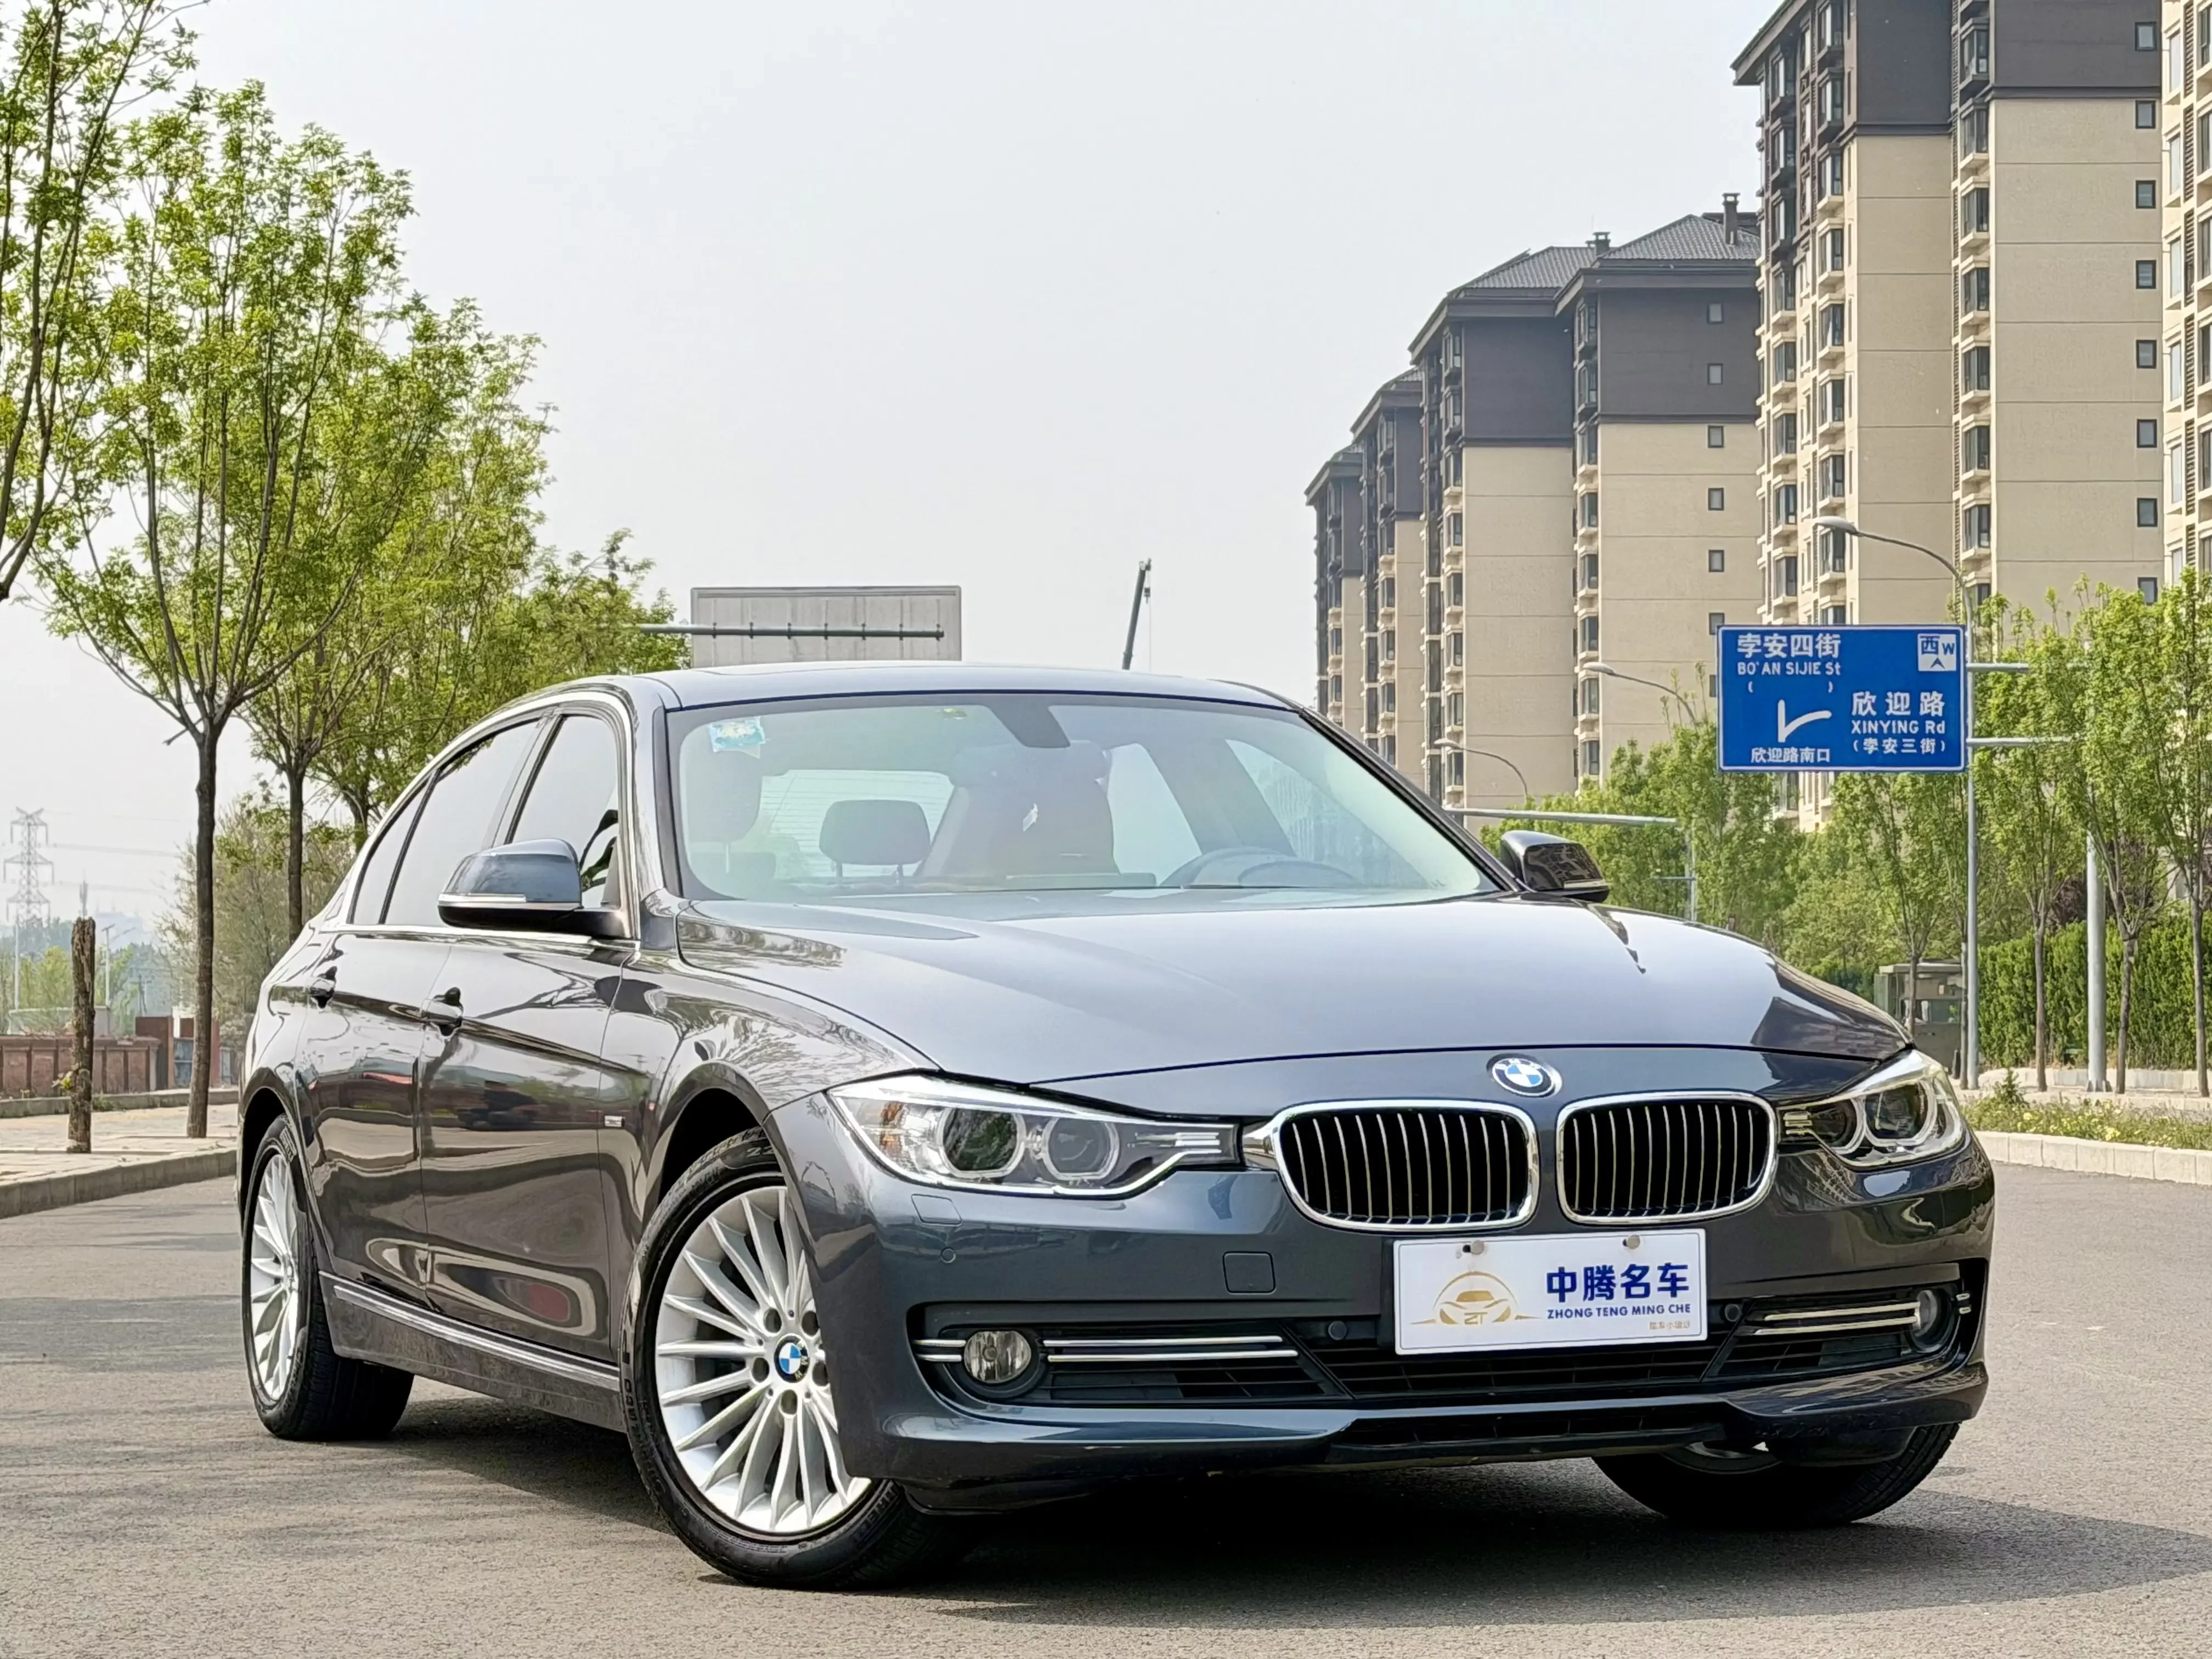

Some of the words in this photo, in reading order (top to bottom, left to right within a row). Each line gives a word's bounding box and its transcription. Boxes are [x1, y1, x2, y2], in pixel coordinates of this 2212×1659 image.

[1737, 633, 1841, 658] 孛安四街
[1920, 635, 1940, 656] 西
[1942, 642, 1955, 655] W
[1786, 662, 1821, 675] SIJIE
[1825, 662, 1841, 675] St
[1851, 691, 1945, 716] 欣迎路
[1851, 719, 1919, 735] XINYING
[1925, 719, 1945, 735] Rd
[1751, 746, 1830, 763] 欣迎路南口
[1547, 1262, 1689, 1302] 中腾名车
[1547, 1307, 1593, 1319] ZHONG
[1596, 1306, 1628, 1317] TENG
[1632, 1305, 1665, 1316] MING
[1668, 1303, 1691, 1313] CHE
